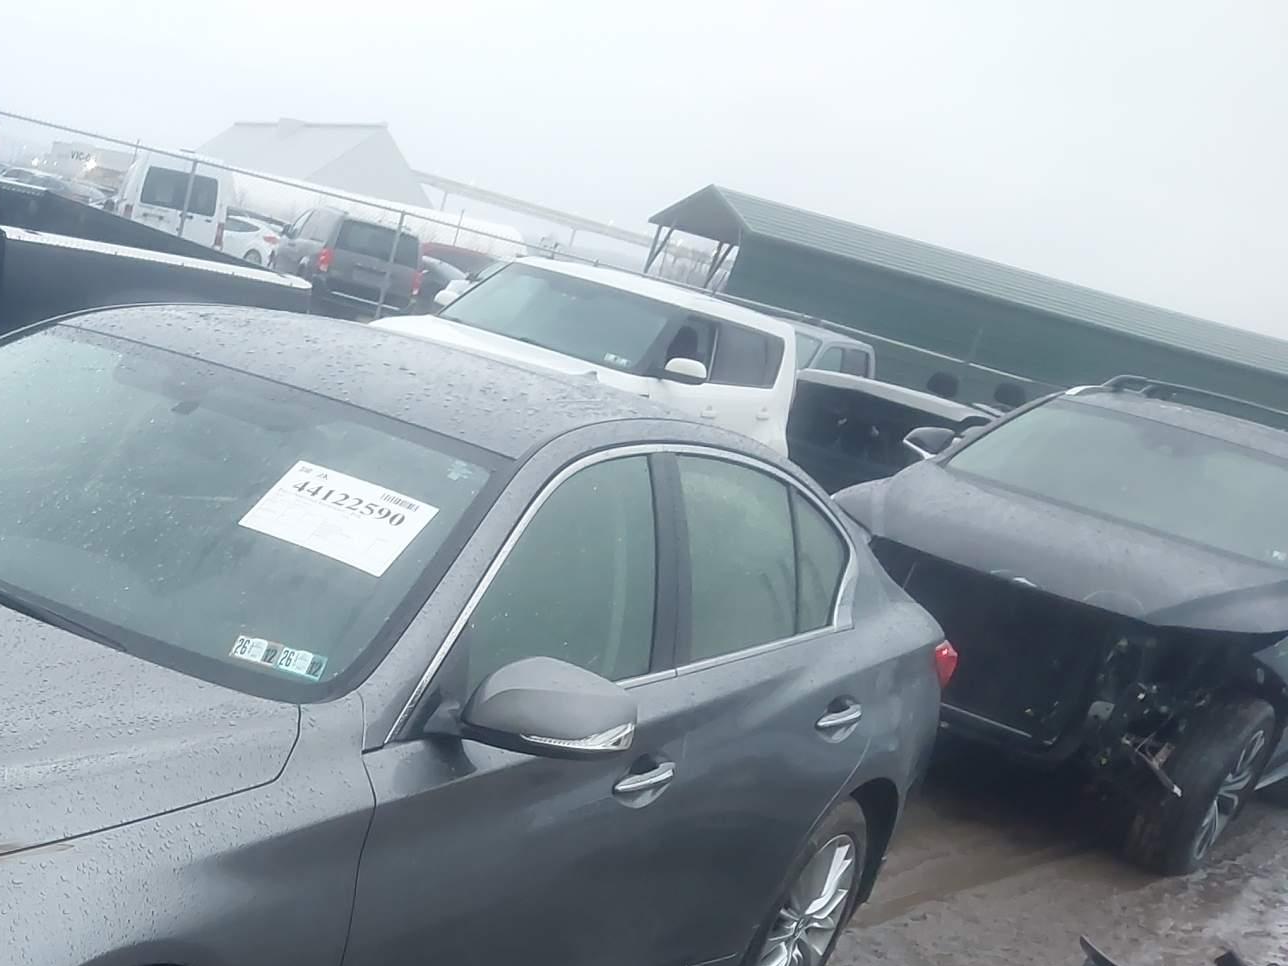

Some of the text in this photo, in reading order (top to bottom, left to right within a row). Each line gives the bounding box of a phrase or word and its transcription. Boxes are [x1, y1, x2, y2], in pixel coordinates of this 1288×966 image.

[292, 480, 406, 527] 44122590
[234, 638, 251, 656] 26
[279, 650, 296, 668] 26
